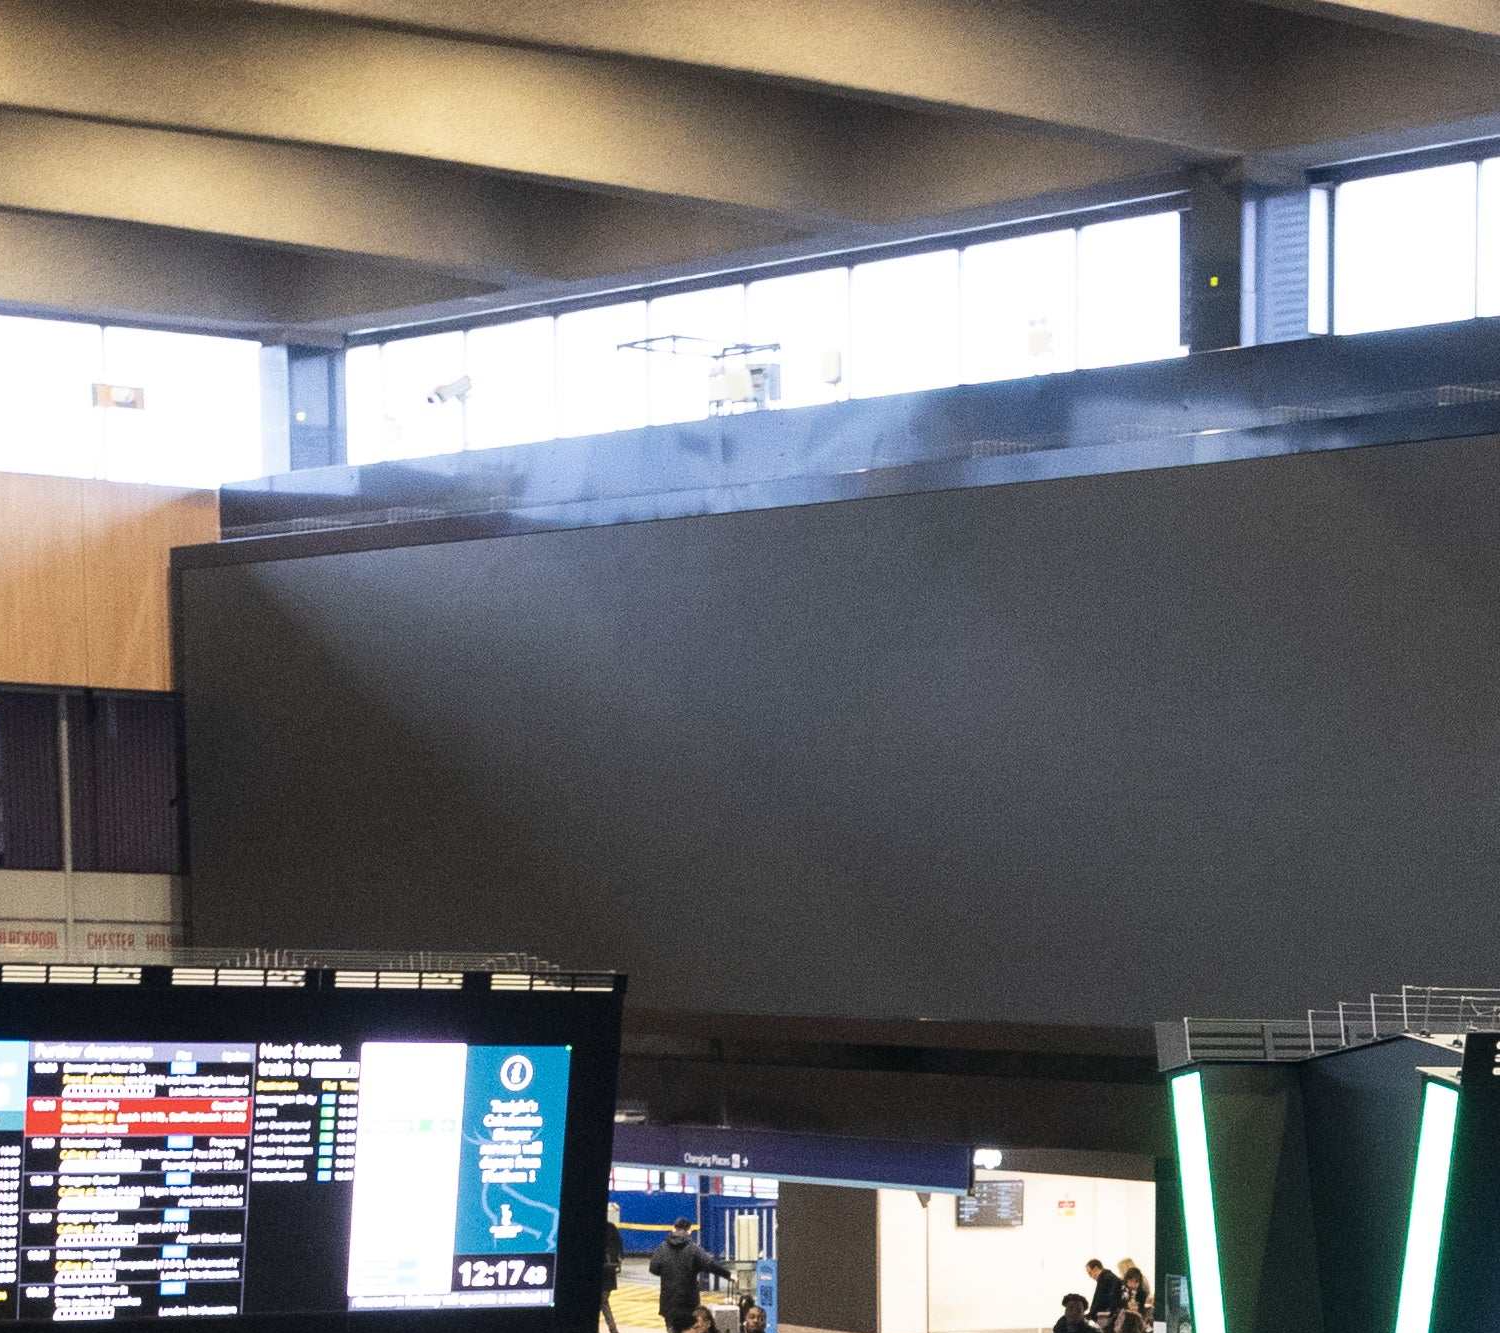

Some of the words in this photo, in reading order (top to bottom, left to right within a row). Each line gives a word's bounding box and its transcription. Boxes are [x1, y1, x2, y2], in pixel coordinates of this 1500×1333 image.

[86, 932, 135, 951] CHESTER
[35, 1043, 83, 1059] Further
[83, 1043, 154, 1062] departures
[259, 1042, 293, 1059] Next
[294, 1042, 342, 1060] fastest
[258, 1060, 292, 1077] train
[293, 1061, 310, 1077] to
[684, 1152, 712, 1168] Changing
[713, 1153, 731, 1167] Places
[458, 1260, 525, 1287] 12:17
